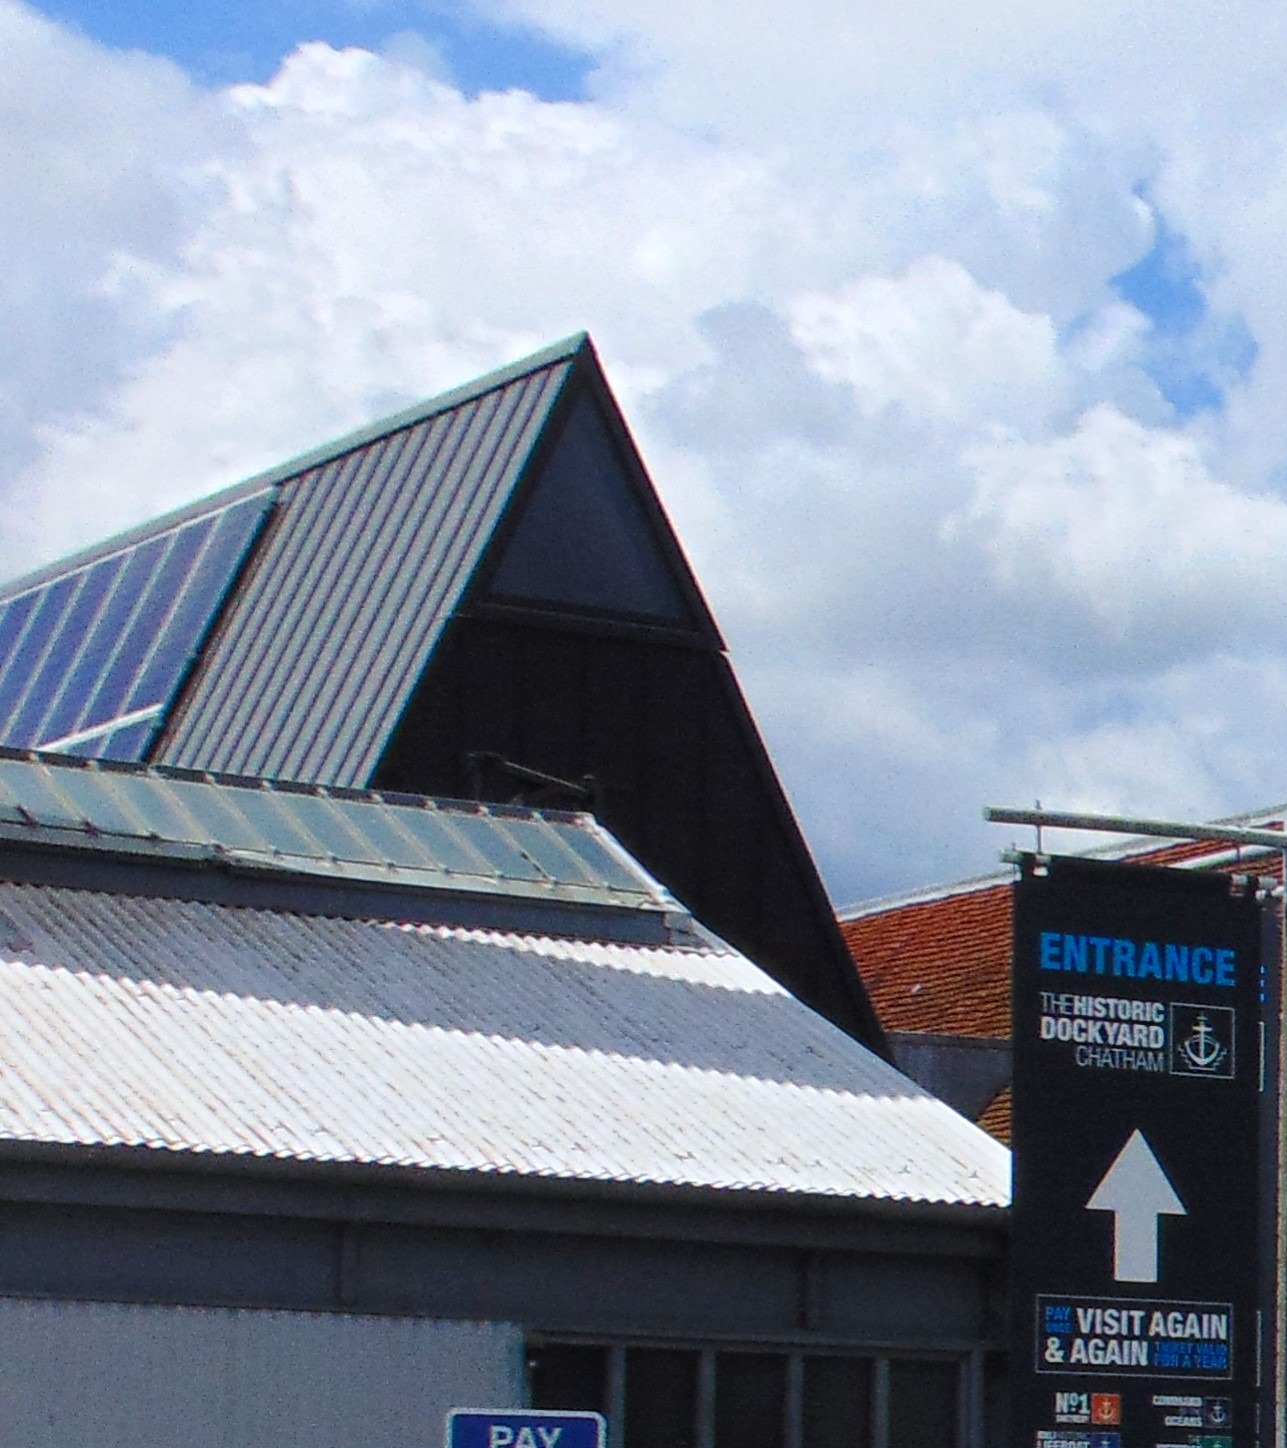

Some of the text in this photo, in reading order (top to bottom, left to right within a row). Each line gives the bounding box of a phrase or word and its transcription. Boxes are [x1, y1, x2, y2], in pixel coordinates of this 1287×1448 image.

[1039, 931, 1236, 987] ENTRANCE
[1039, 991, 1165, 1023] THE HISTORIC
[1039, 1015, 1165, 1049] DOCKYARD
[1076, 1045, 1164, 1072] CHATHAM
[1045, 1306, 1071, 1321] PAY
[1076, 1307, 1227, 1340] VISIT AGAIN
[1044, 1336, 1148, 1366] & AGAIN
